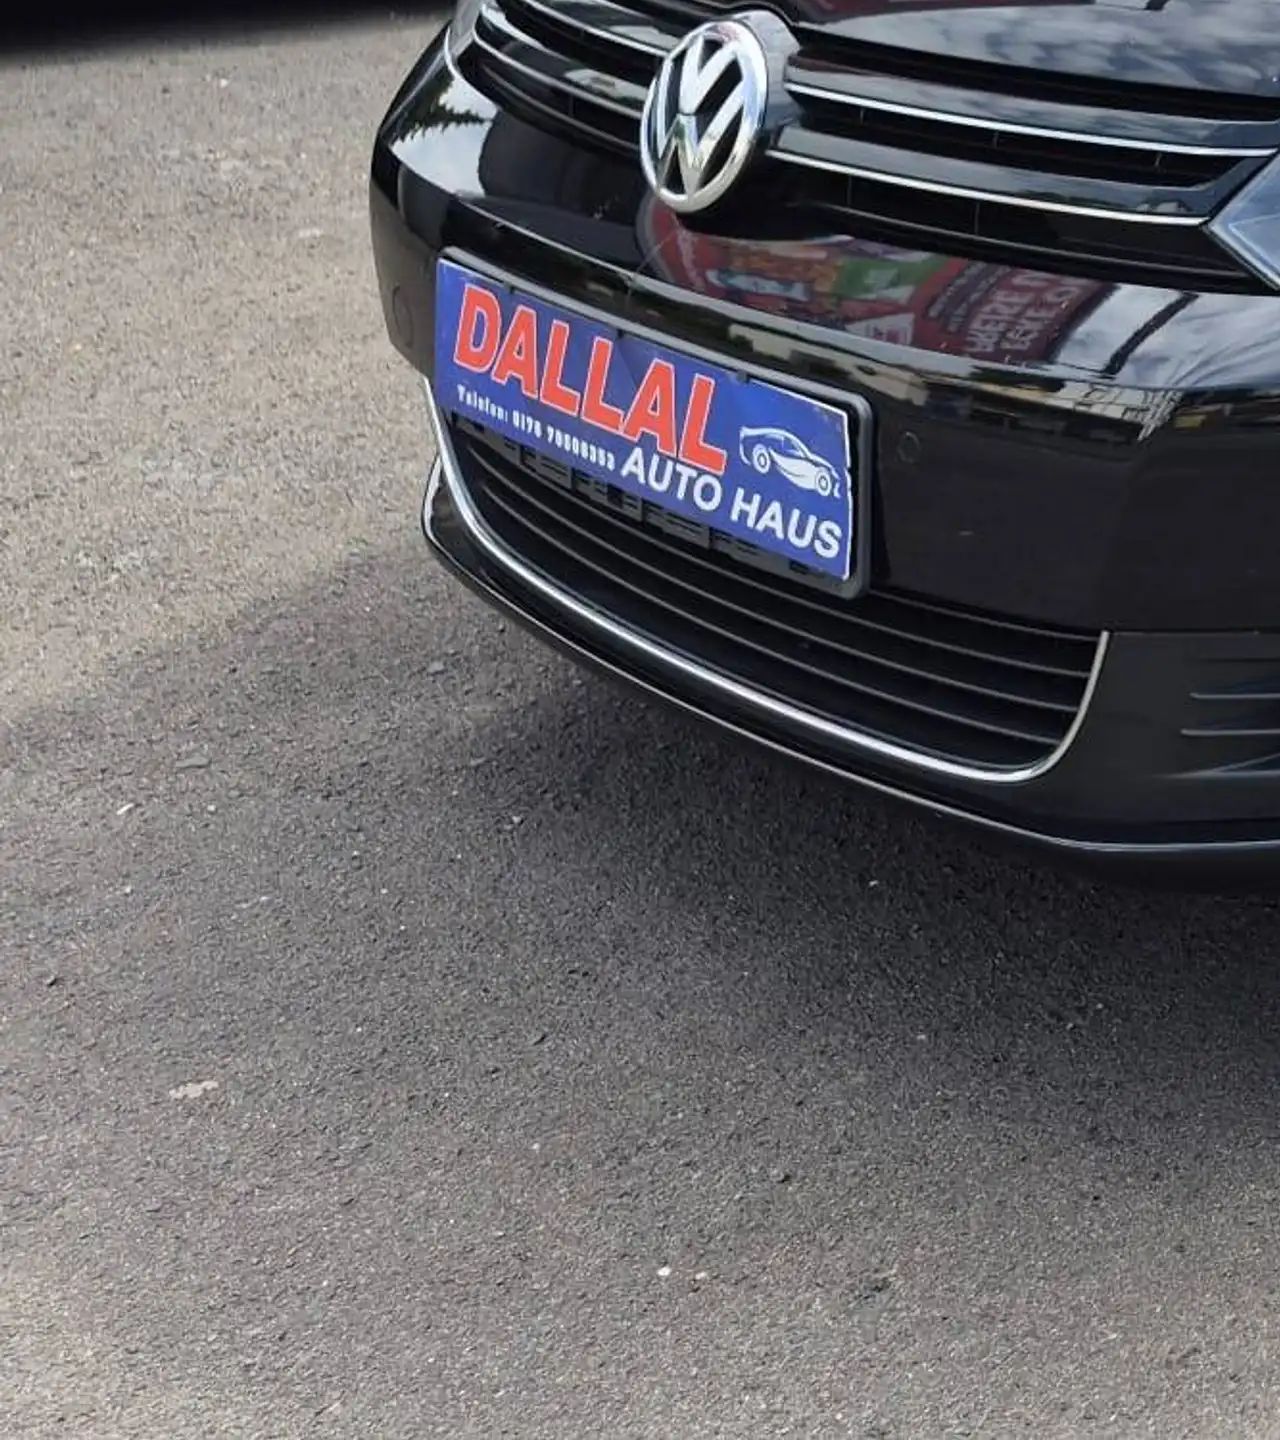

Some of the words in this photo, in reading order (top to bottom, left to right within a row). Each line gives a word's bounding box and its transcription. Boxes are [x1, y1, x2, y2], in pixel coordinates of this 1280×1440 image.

[454, 283, 728, 476] DALLAL
[621, 446, 723, 512] AUTO
[730, 487, 843, 559] HAUS
